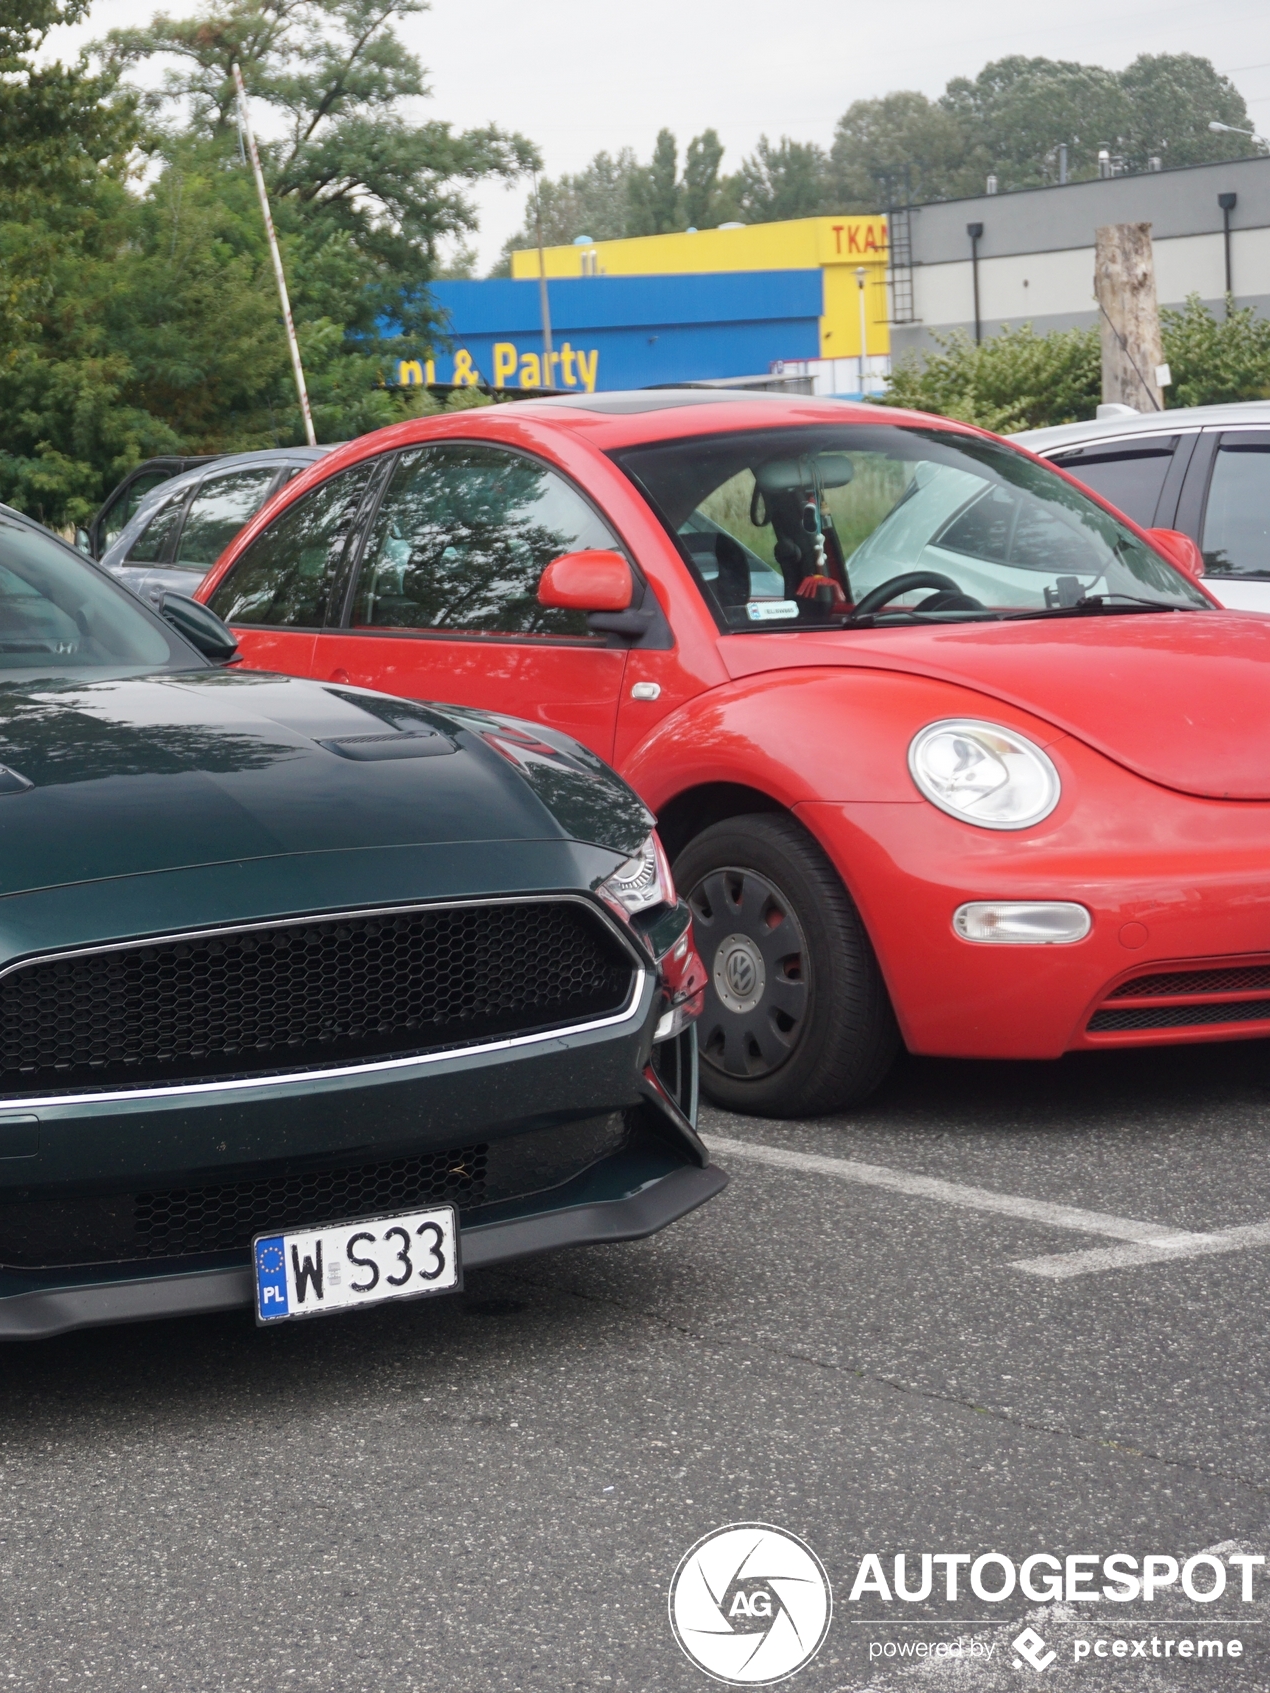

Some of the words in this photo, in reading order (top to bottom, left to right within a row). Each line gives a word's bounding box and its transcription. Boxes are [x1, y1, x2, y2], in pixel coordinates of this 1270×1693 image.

[454, 349, 479, 387] &
[493, 341, 599, 394] Party
[290, 1238, 324, 1304] W
[346, 1220, 446, 1293] S33
[263, 1285, 285, 1304] PL
